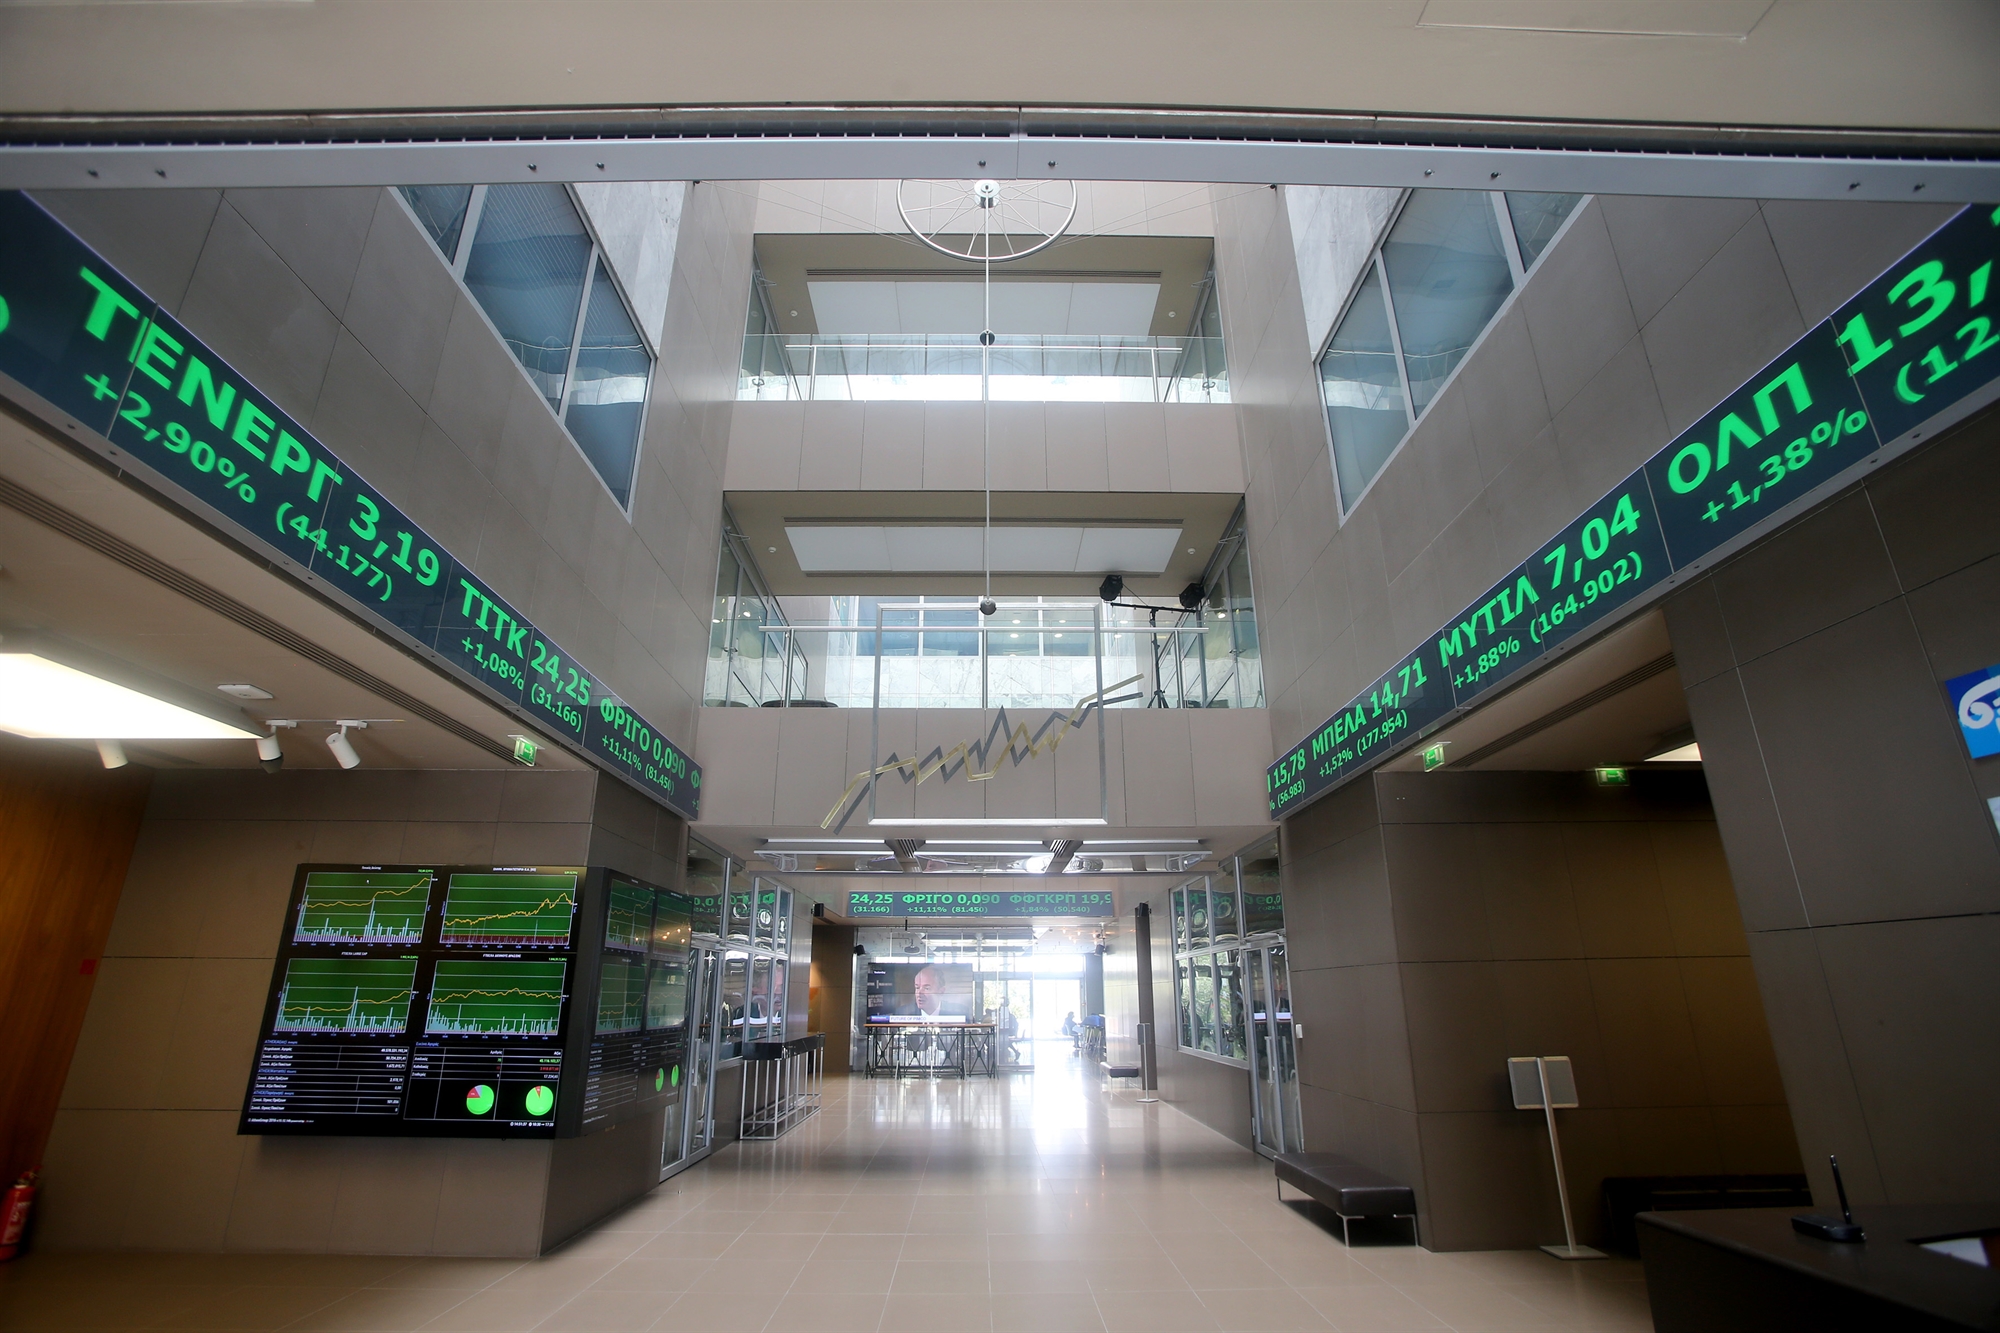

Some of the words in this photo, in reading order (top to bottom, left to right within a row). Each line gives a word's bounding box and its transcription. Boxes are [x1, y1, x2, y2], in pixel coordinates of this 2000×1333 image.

[79, 265, 343, 503] ΤΕΝΕΡΓ
[349, 493, 440, 587] 3,19
[460, 577, 528, 660] ΤΙΤΚ
[530, 639, 591, 706] 24,25
[600, 697, 650, 752] ΦΡΙΓΟ
[653, 738, 686, 779] 0,090
[83, 373, 256, 503] +2,90%
[276, 501, 393, 601] (44.177)
[461, 636, 525, 691] +1,08%
[531, 682, 582, 733] (31.166)
[601, 734, 642, 771] +11,11%
[645, 763, 675, 796] (81.450)
[1274, 748, 1306, 789] 15,78
[1311, 703, 1367, 761] ΜΠΕΛΑ
[1370, 657, 1427, 719] 14,71
[1438, 575, 1540, 668] ΜΥΤΙΛ
[1544, 492, 1641, 590] 7,04
[1668, 361, 1813, 494] ΟΛΠ
[1835, 205, 2000, 377] 13,
[1277, 778, 1306, 809] (56.983)
[1319, 746, 1353, 778] +1,52%
[1357, 708, 1408, 757] (177.954)
[1453, 635, 1521, 690] +1,88%
[1529, 550, 1643, 644] (164.902)
[1700, 407, 1868, 524] +1,38%
[850, 893, 893, 905] 24,25
[902, 893, 953, 905] ΦΡΙΓΟ
[957, 893, 1000, 905] 0,090
[853, 906, 890, 914] (31.166)
[906, 906, 947, 914] +11,11%
[951, 906, 988, 914] (81.450)
